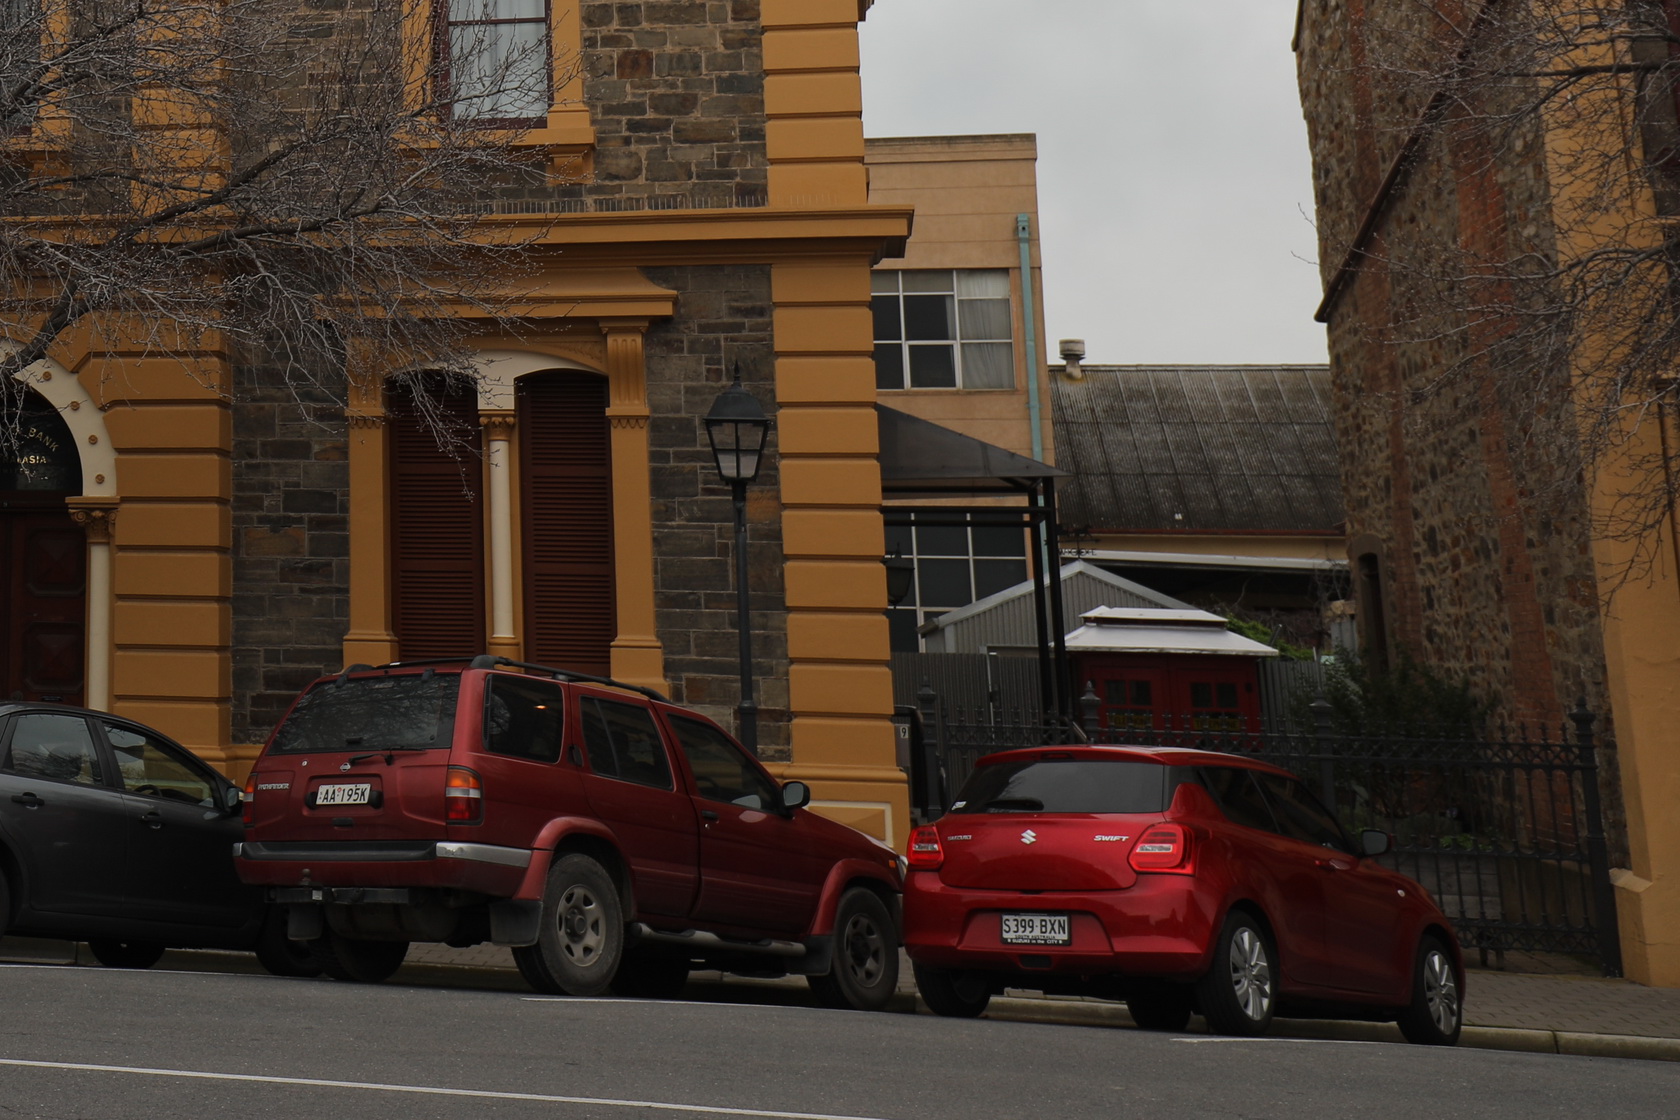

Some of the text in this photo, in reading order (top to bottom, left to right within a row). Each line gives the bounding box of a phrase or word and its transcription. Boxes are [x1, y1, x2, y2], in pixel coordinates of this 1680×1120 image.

[28, 427, 60, 452] BANK
[901, 727, 907, 737] 9
[1093, 834, 1131, 842] SWIFT
